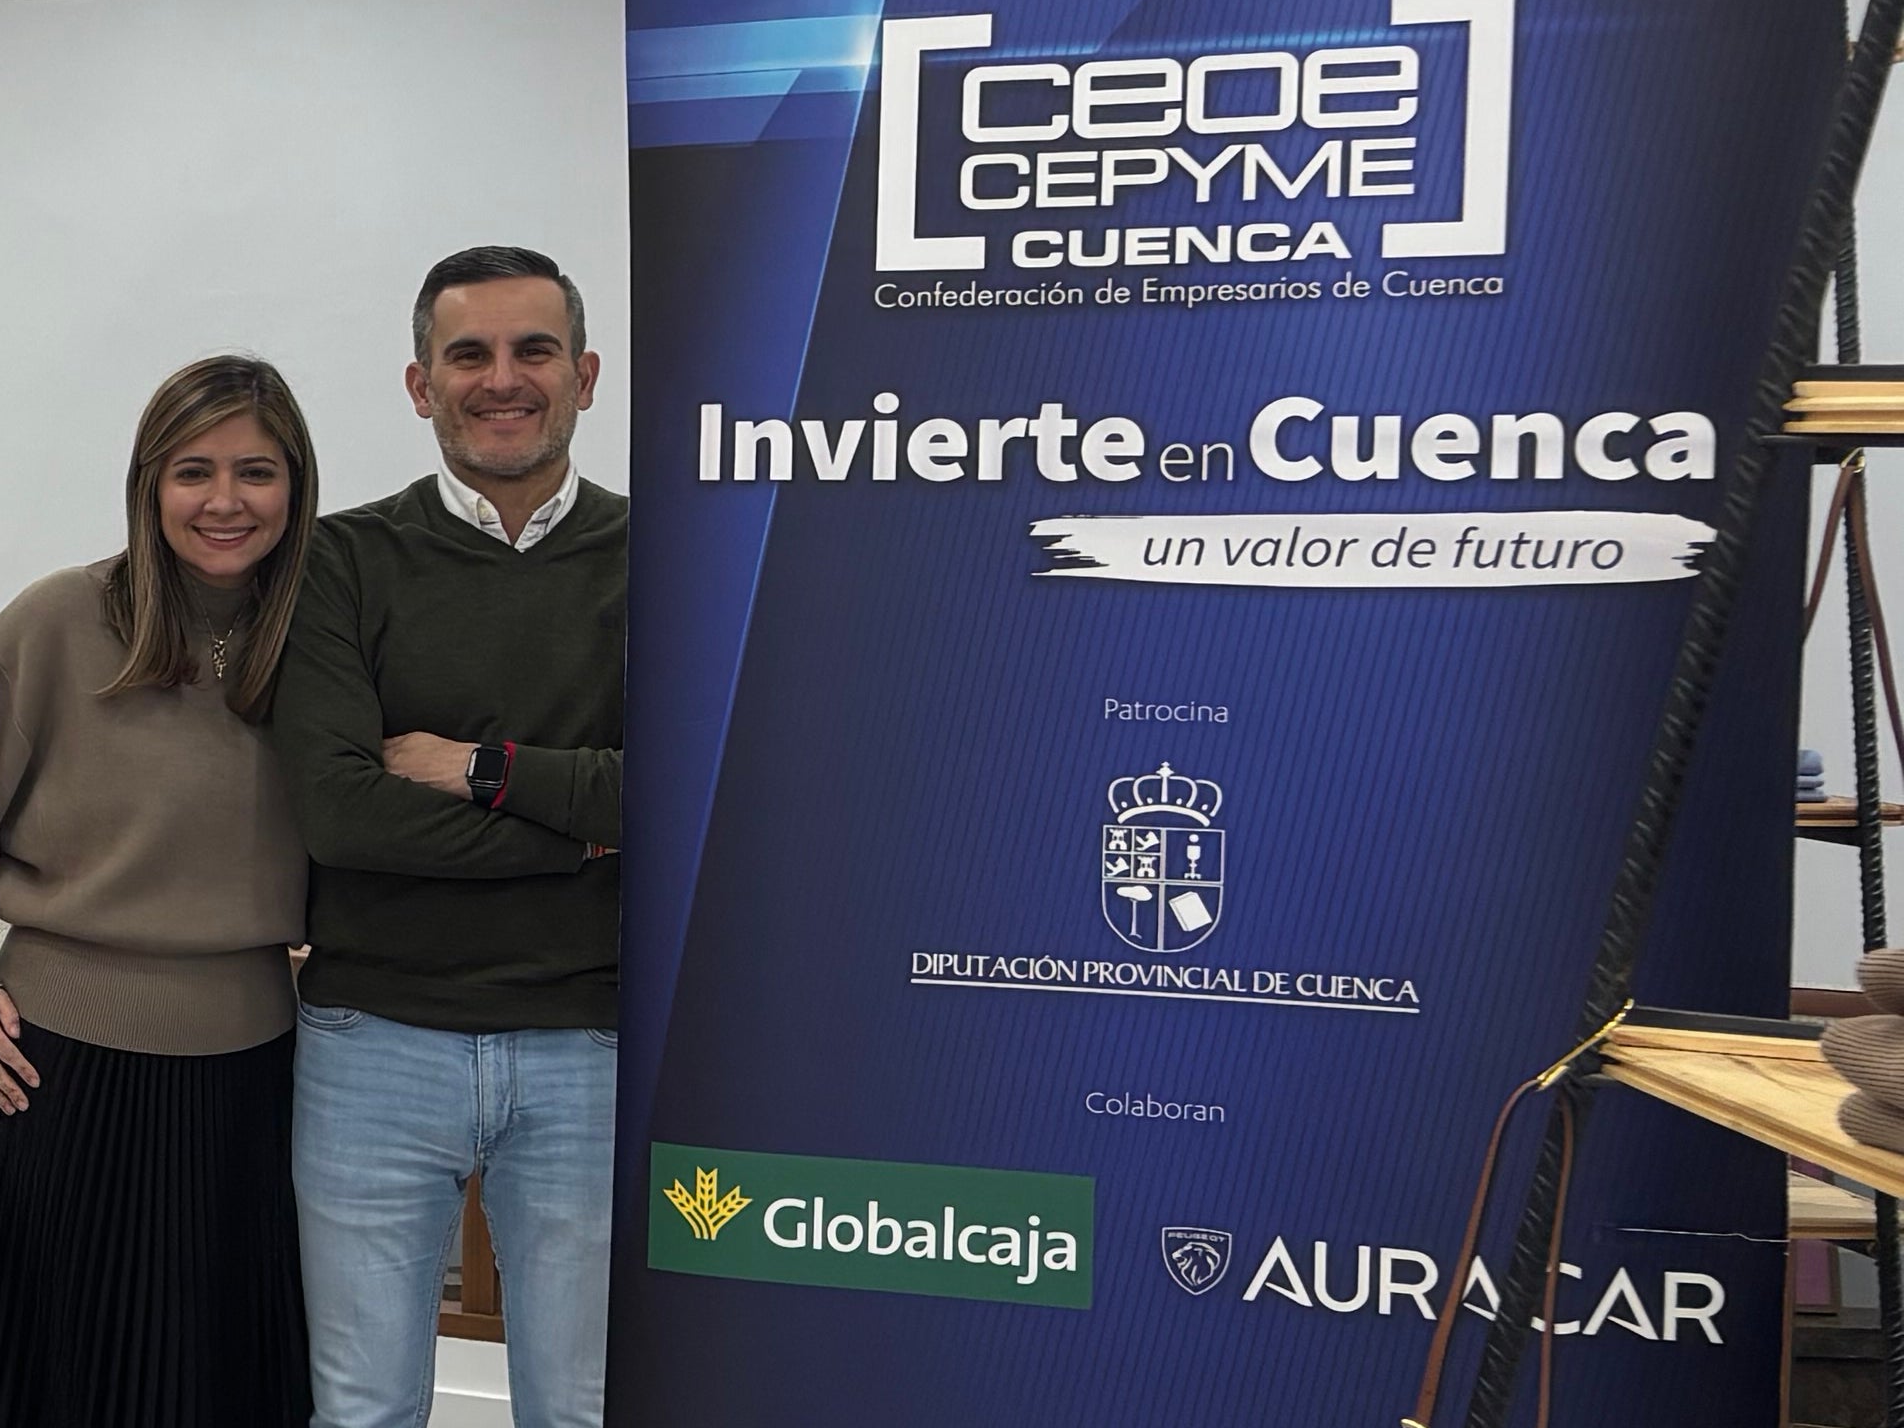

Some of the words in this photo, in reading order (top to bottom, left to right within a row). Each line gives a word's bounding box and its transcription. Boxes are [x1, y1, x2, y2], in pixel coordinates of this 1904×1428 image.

[962, 44, 1419, 143] ceoe
[959, 136, 1417, 211] CEPYME
[1012, 222, 1353, 269] CUENCA
[874, 280, 1084, 309] Confederación
[1094, 277, 1131, 305] de
[1142, 275, 1322, 309] Empresarios
[1332, 271, 1371, 298] de
[1382, 270, 1504, 298] Cuenca
[698, 392, 1145, 482] Invierte
[1159, 443, 1234, 482] en
[1249, 396, 1717, 481] Cuenca
[1142, 537, 1206, 569] un
[1222, 525, 1360, 570] valor
[1370, 526, 1438, 570] de
[1450, 523, 1625, 573] futuro
[1104, 698, 1229, 724] Patrocina
[910, 951, 1078, 981] DIPUTACIÓN
[1082, 961, 1247, 993] PROVINCIAL
[1252, 970, 1291, 995] DE
[1296, 973, 1420, 1004] CUENCA
[1085, 1091, 1225, 1124] Colaboran
[762, 1196, 1078, 1286] Globalcaja
